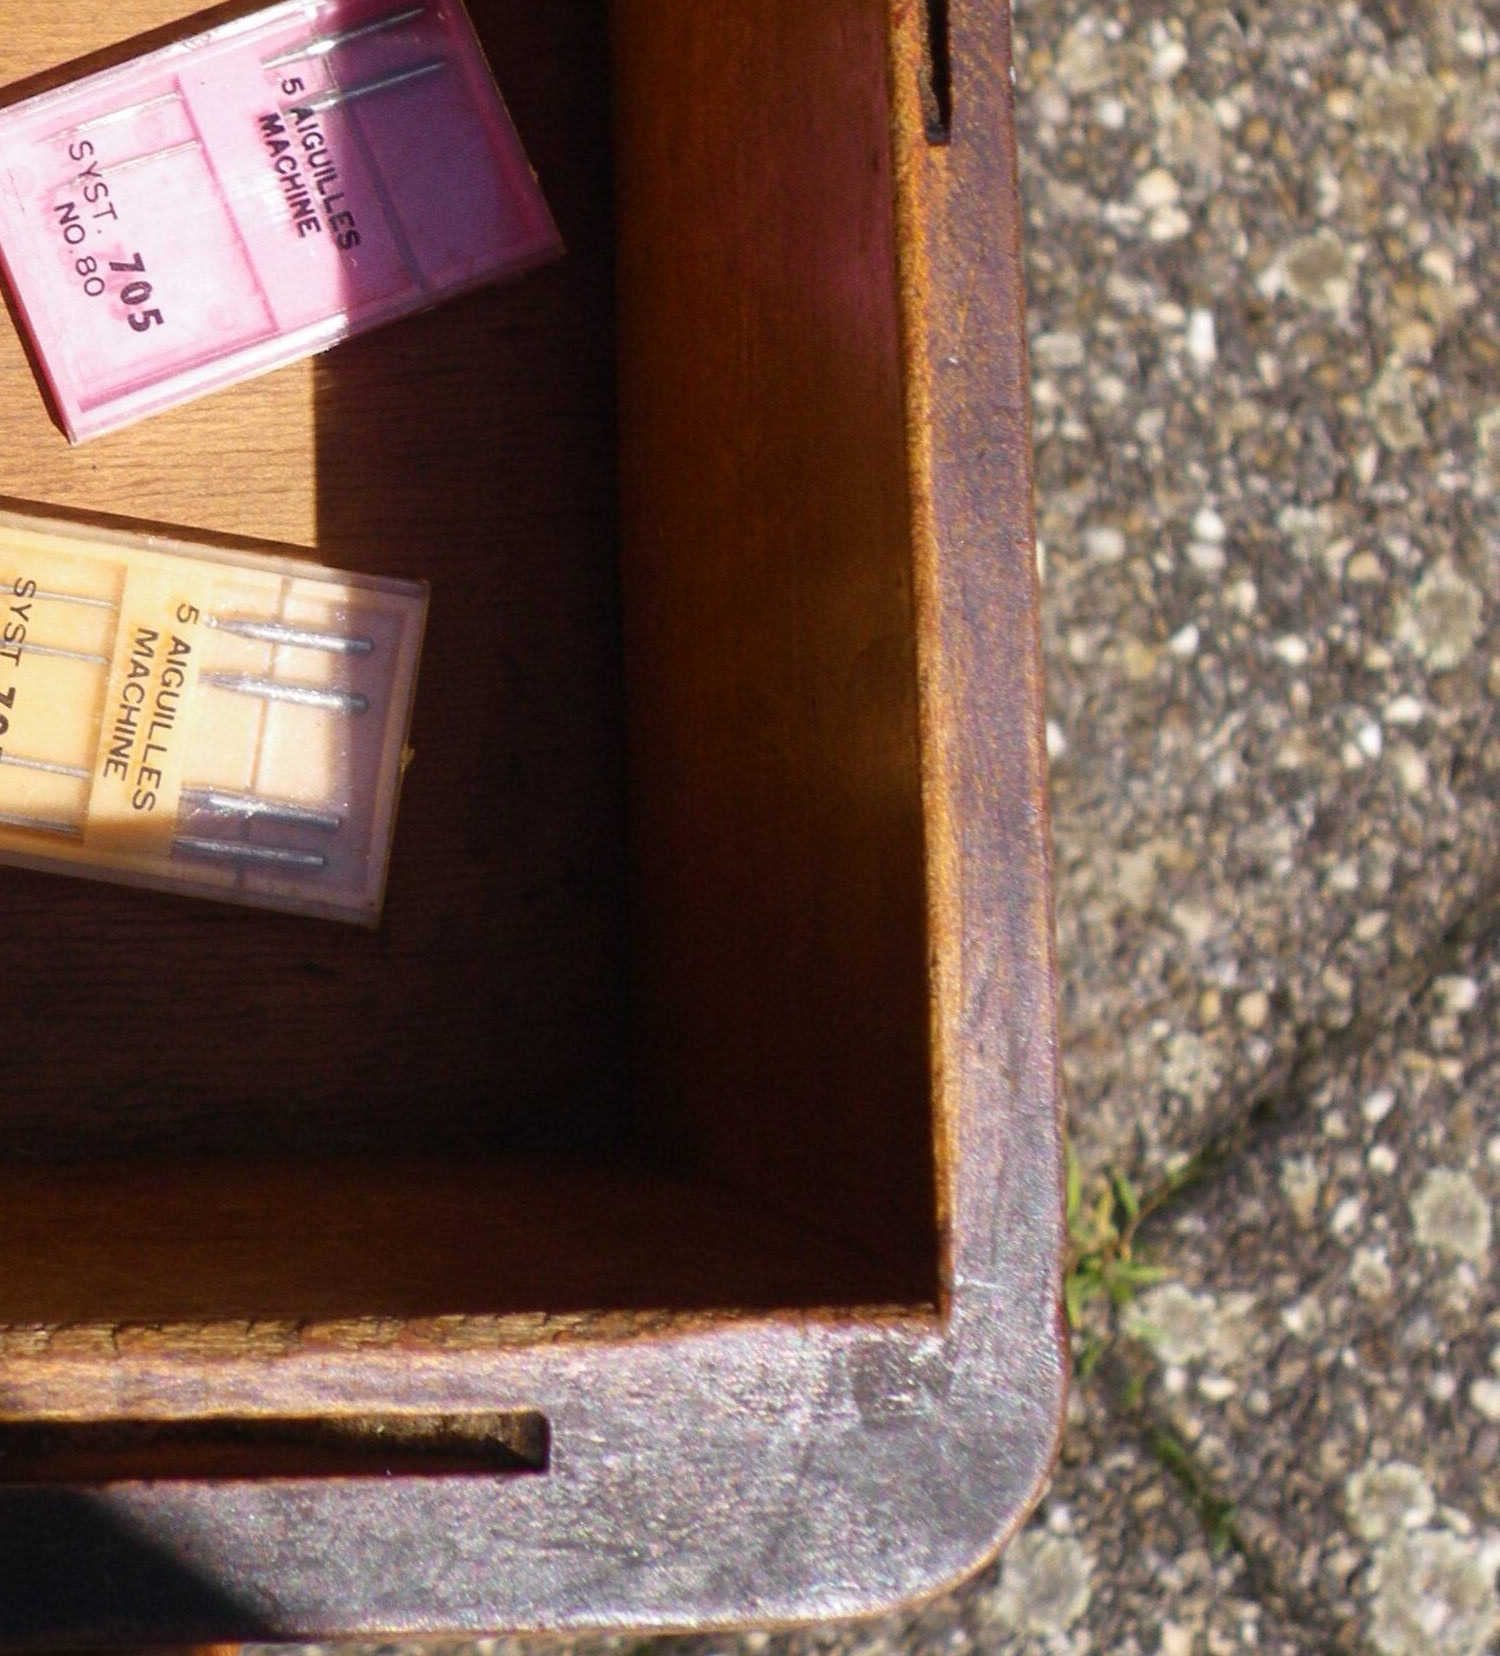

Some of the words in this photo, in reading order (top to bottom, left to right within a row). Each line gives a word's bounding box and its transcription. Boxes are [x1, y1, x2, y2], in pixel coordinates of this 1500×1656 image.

[281, 77, 305, 95] 5
[68, 140, 118, 234] SYST.
[108, 252, 165, 333] 705
[258, 112, 322, 238] MACHINE
[289, 107, 361, 250] AIGUILLES
[176, 603, 200, 625] 5
[102, 627, 160, 782] MACHINE
[132, 635, 192, 812] AIGUILLES
